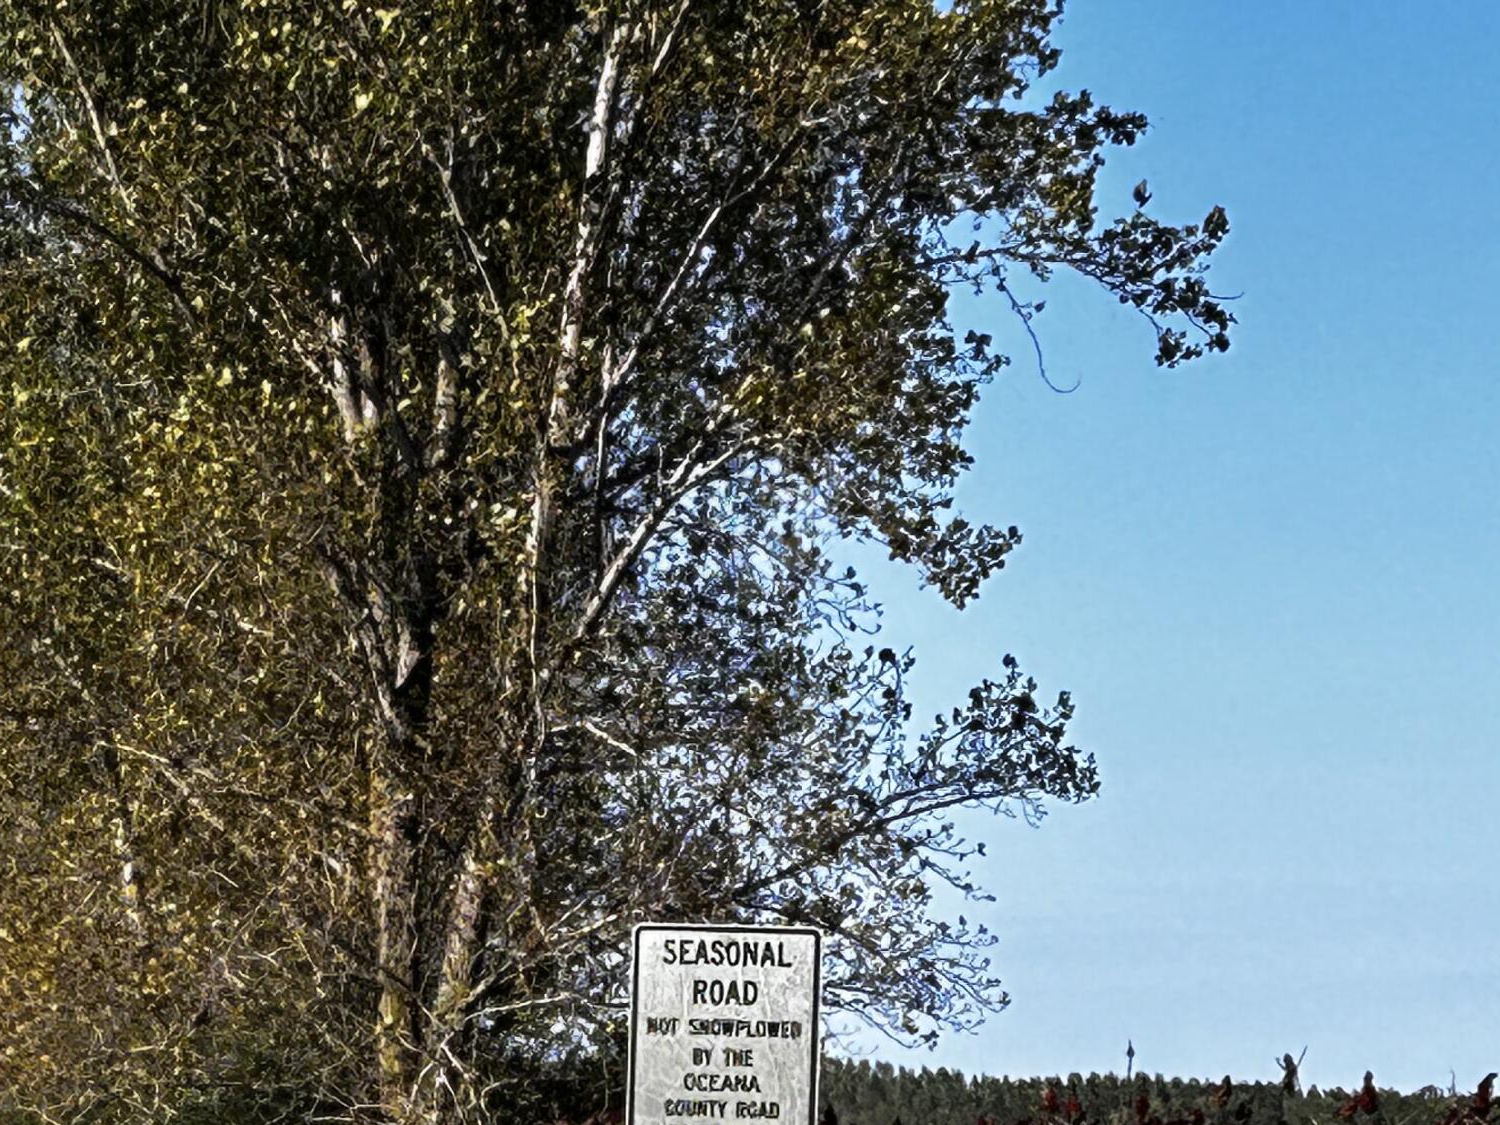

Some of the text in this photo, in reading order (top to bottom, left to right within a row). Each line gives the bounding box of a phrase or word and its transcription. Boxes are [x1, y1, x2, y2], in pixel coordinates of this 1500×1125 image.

[662, 939, 792, 968] SEASONAL
[693, 980, 758, 1006] ROAD
[693, 1048, 754, 1068] BY THE
[683, 1074, 761, 1093] OCEANA
[664, 1098, 780, 1119] COUNTY ROAD
